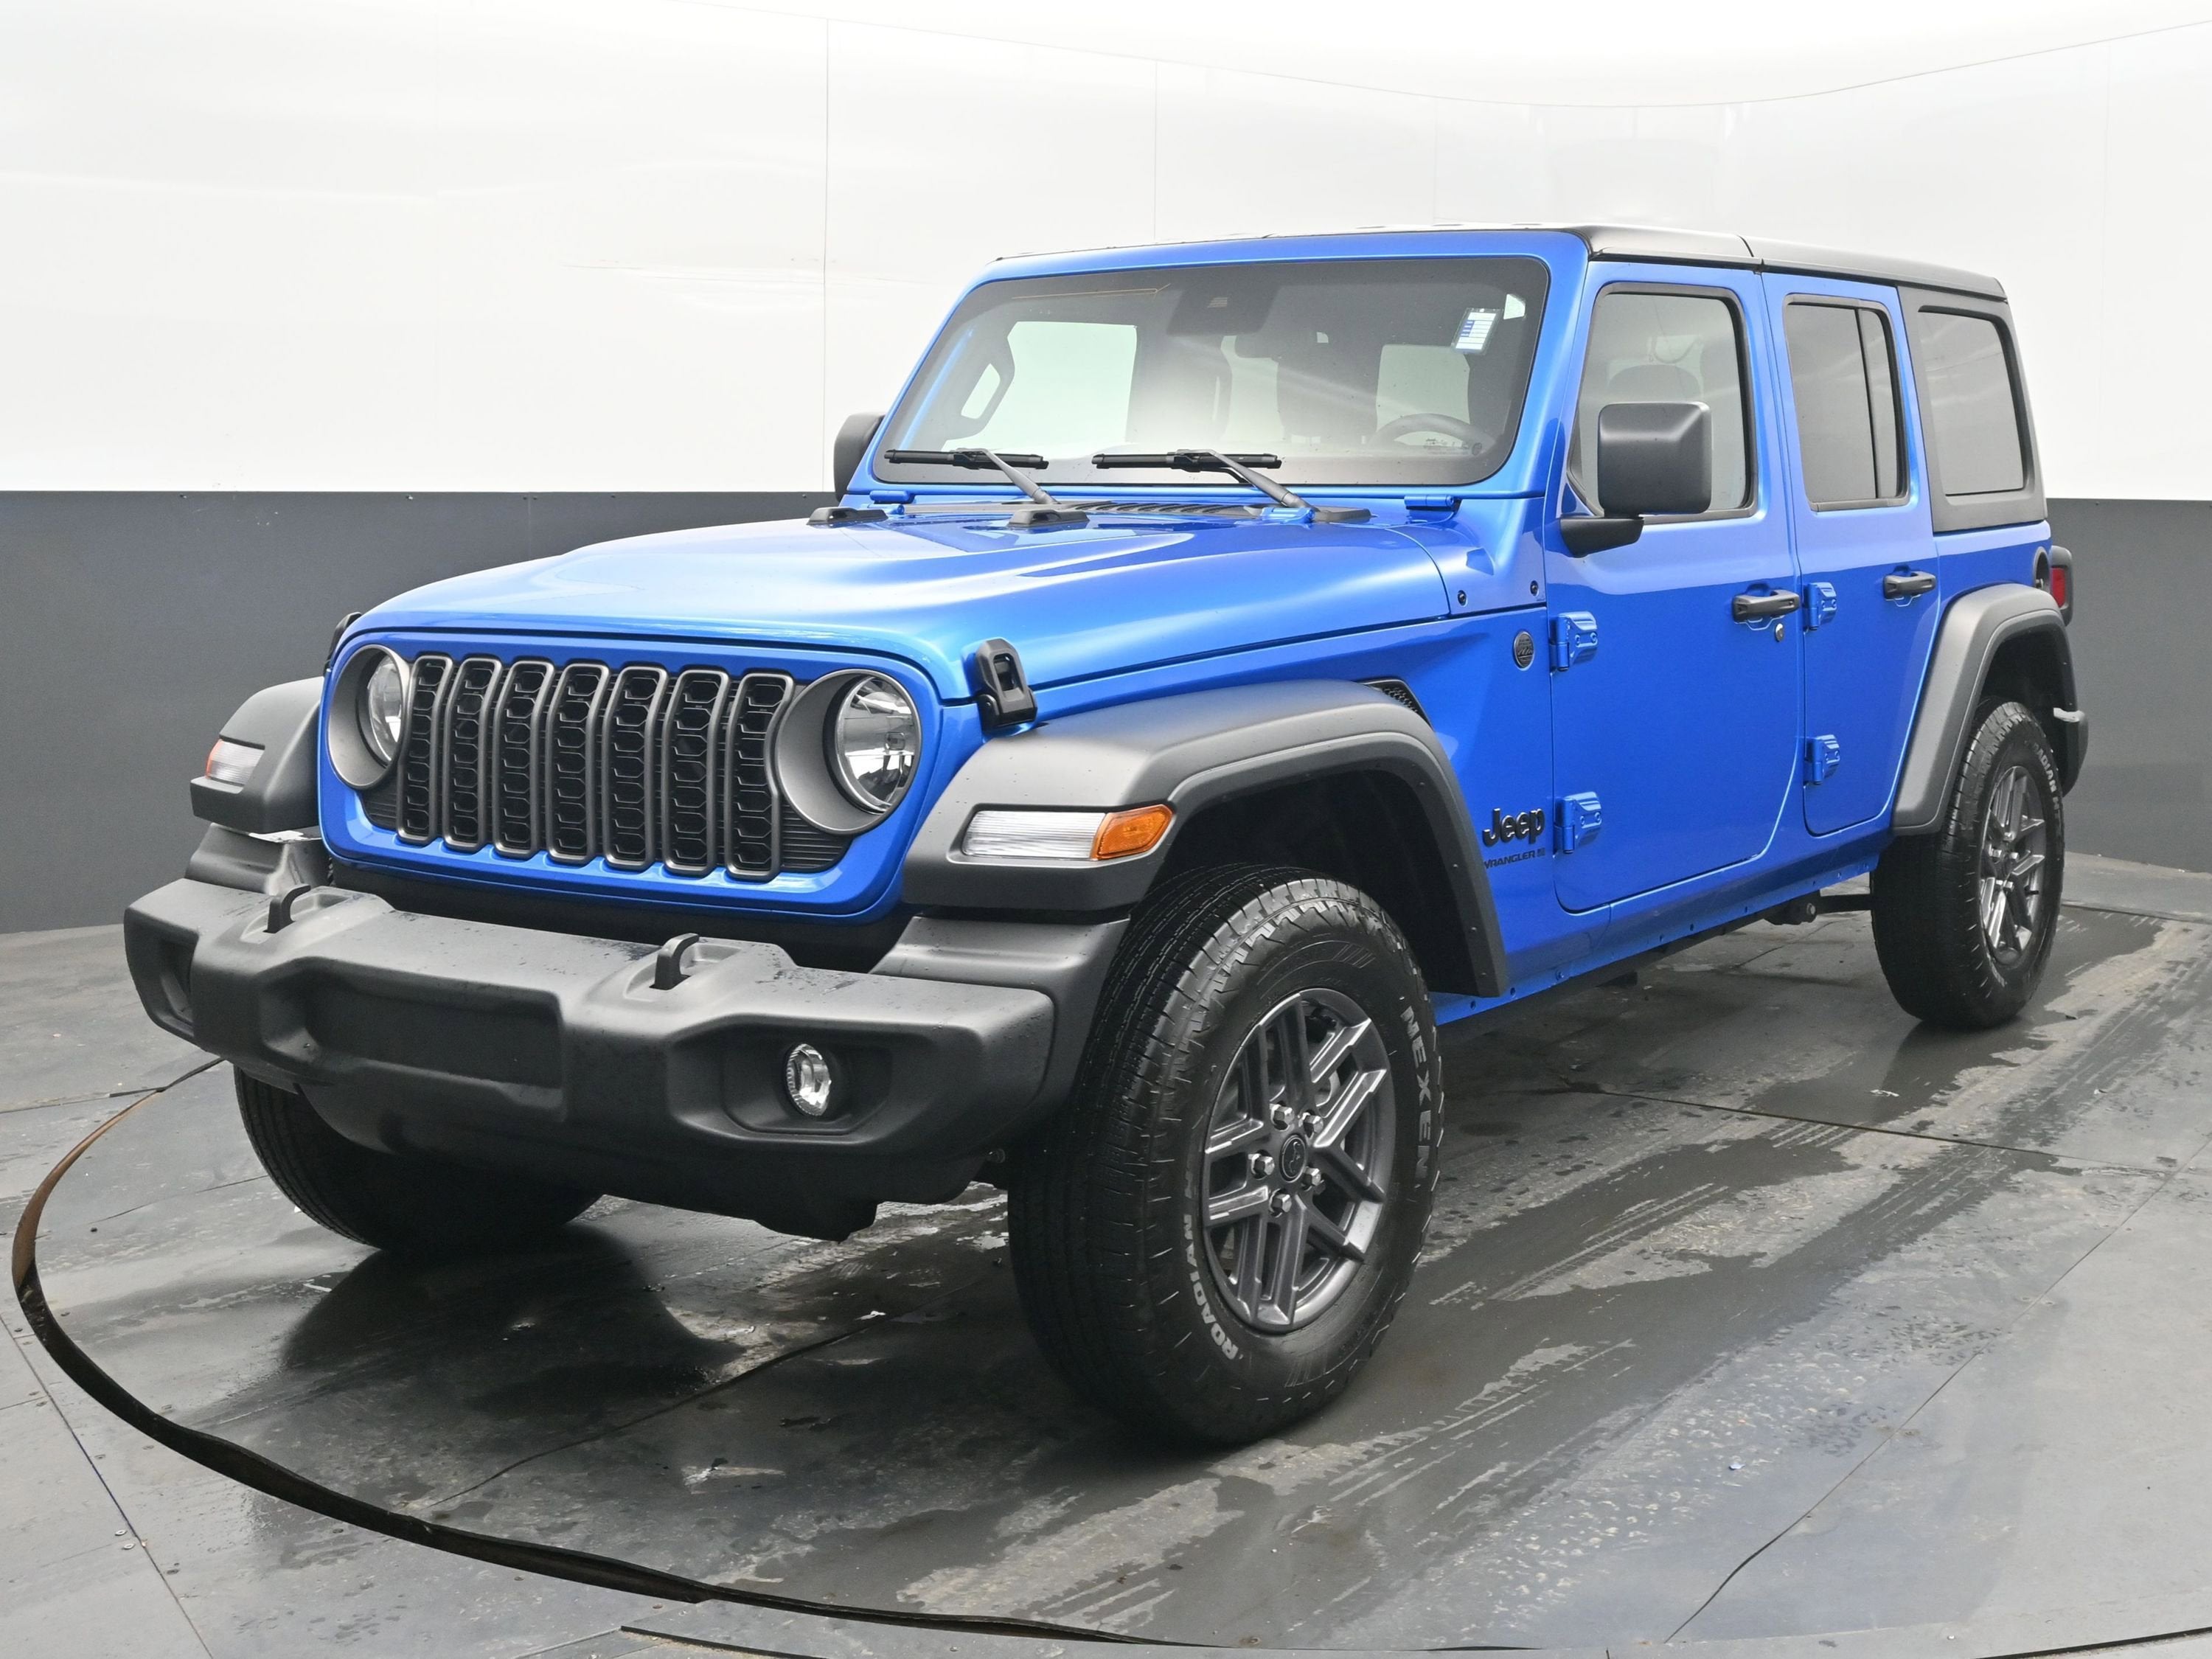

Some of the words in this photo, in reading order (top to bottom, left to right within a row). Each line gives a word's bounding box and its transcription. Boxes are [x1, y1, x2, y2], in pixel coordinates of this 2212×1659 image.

[1482, 808, 1545, 846] Jeep
[1401, 1006, 1431, 1178] NEXEN
[1183, 1214, 1239, 1360] ROADIAN
